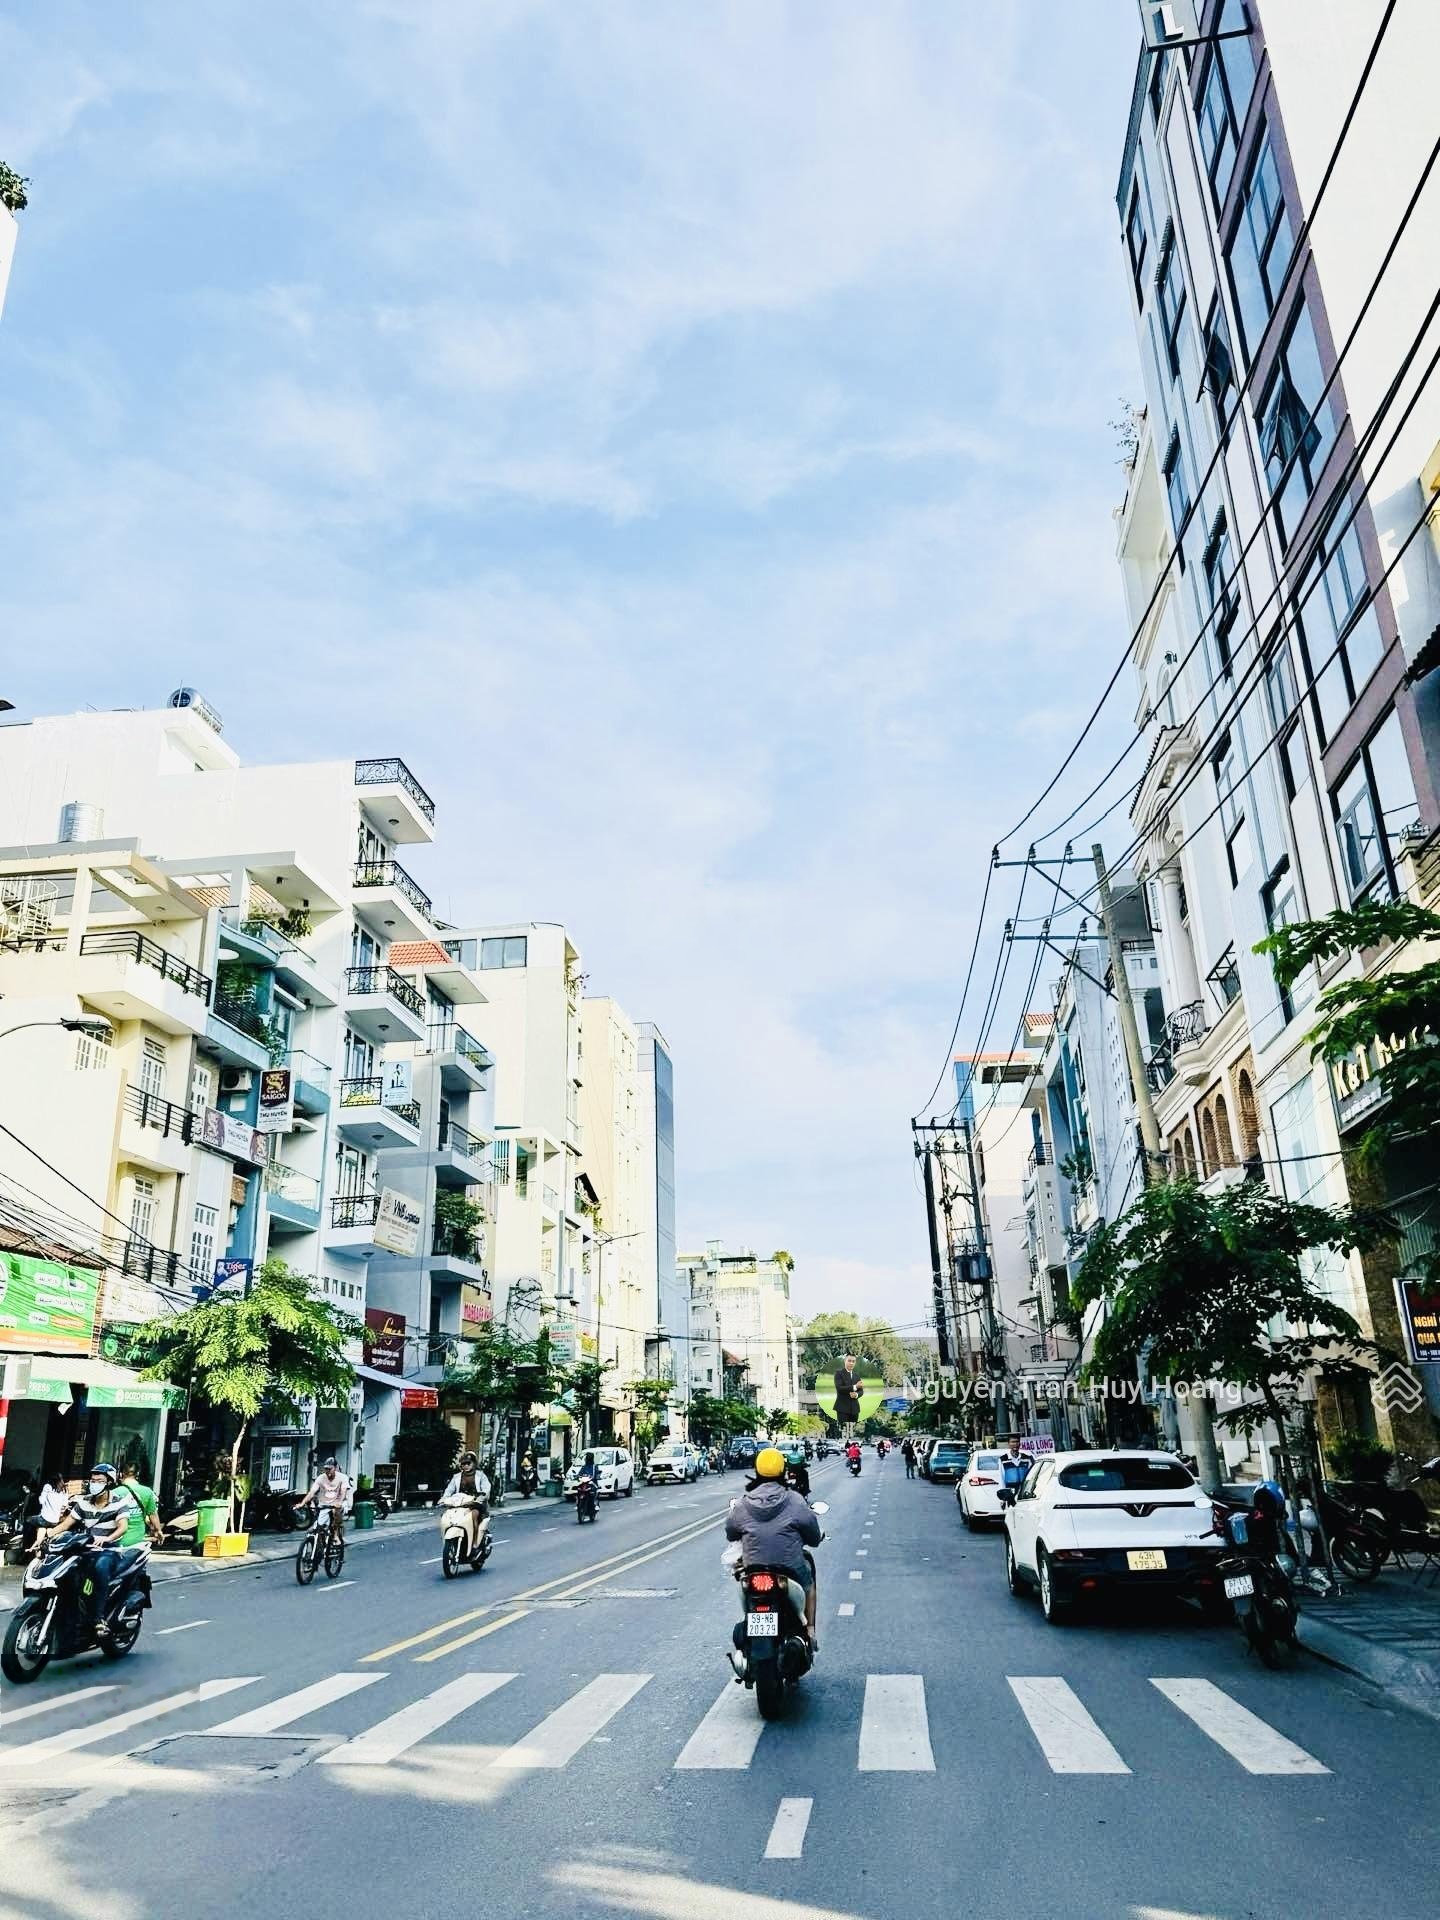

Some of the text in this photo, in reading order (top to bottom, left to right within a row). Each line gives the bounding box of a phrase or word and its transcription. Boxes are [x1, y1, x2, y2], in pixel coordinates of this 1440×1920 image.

[261, 1092, 287, 1102] SAIGON
[225, 1261, 247, 1273] Tiger
[1417, 1332, 1437, 1346] QUA
